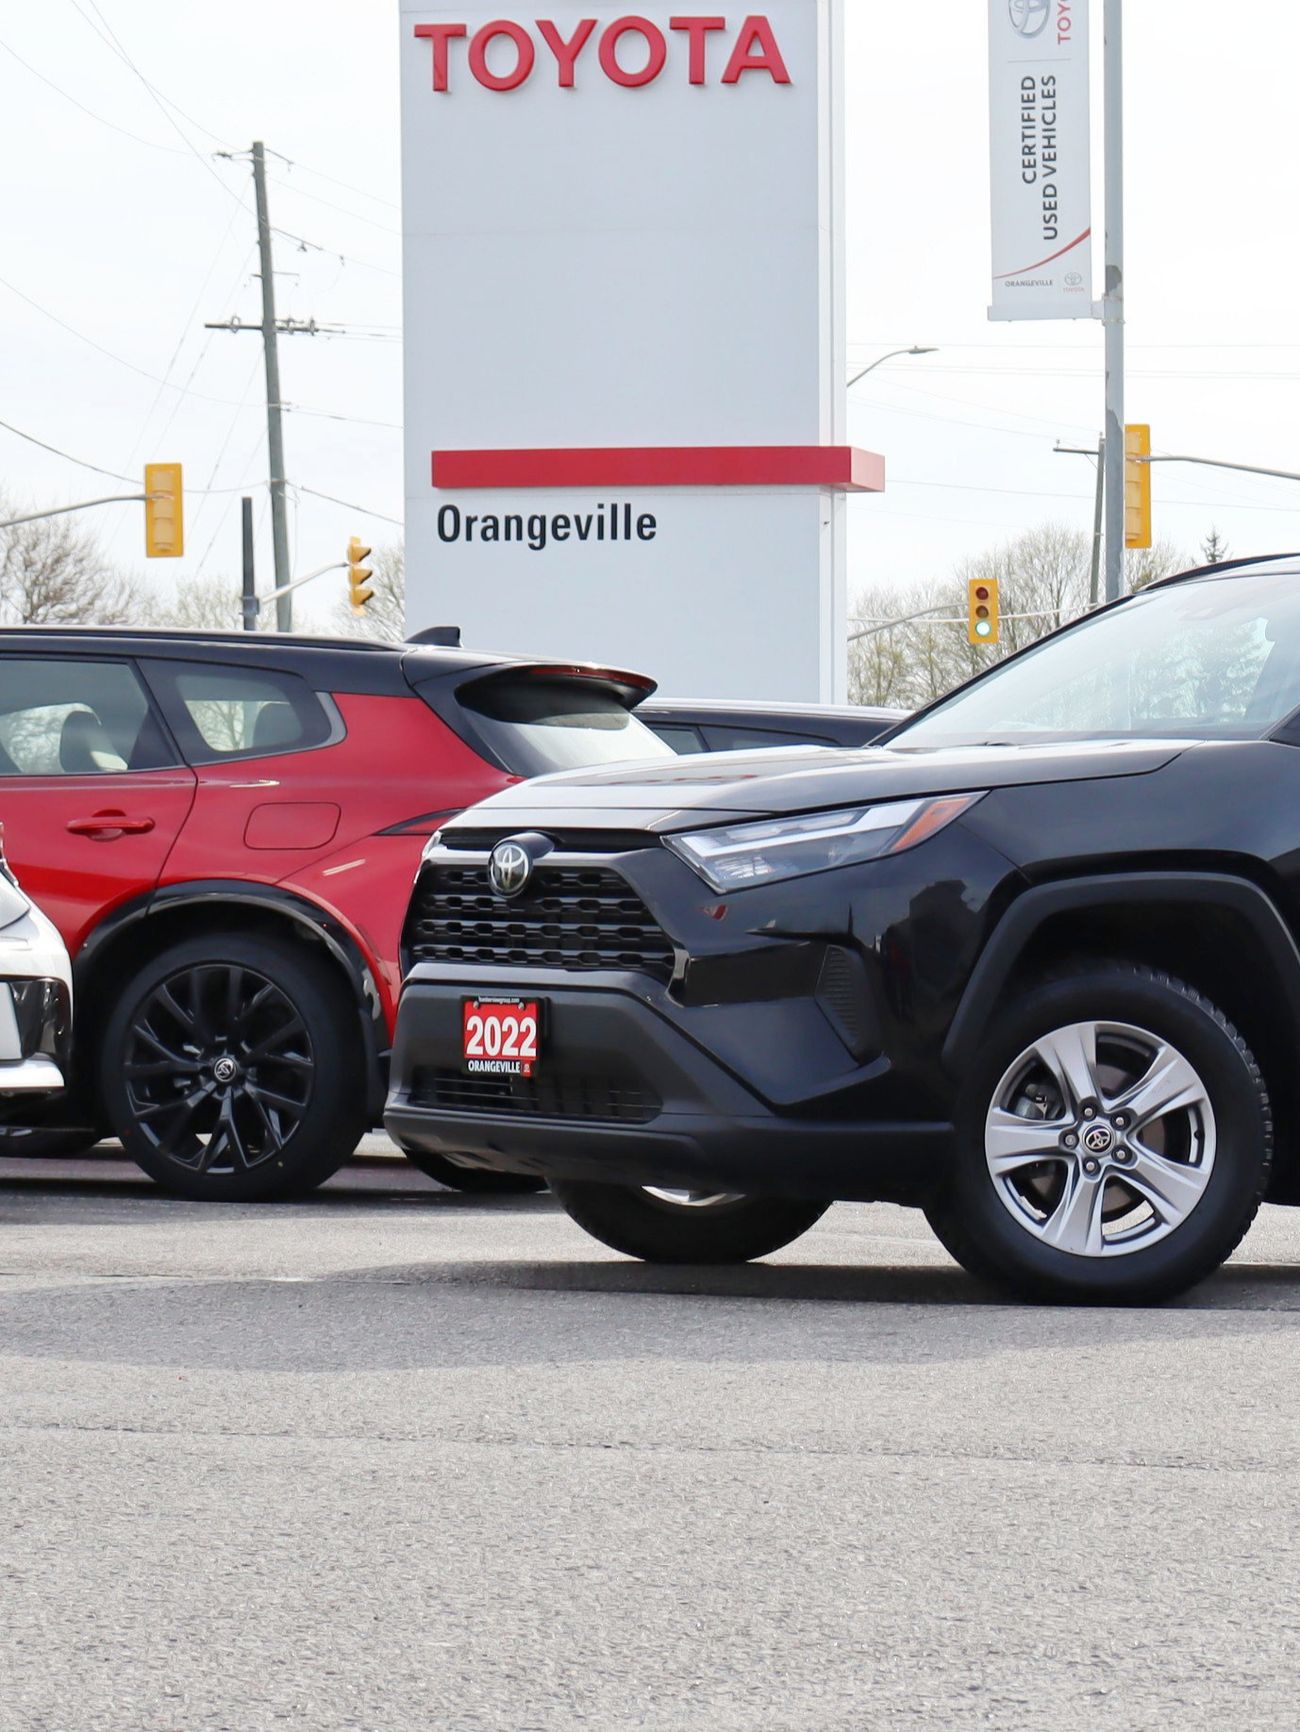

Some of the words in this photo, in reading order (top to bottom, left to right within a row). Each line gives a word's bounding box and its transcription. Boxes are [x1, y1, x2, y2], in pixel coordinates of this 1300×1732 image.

[1057, 0, 1071, 45] TOY
[414, 16, 791, 92] TOYOTA
[1021, 76, 1037, 184] CERTIFIED
[1041, 75, 1057, 178] VEHICLES
[1043, 183, 1058, 240] USED
[437, 504, 657, 550] Orangeville
[466, 1015, 537, 1057] 2022
[468, 1060, 521, 1073] ORANGEVILLE
